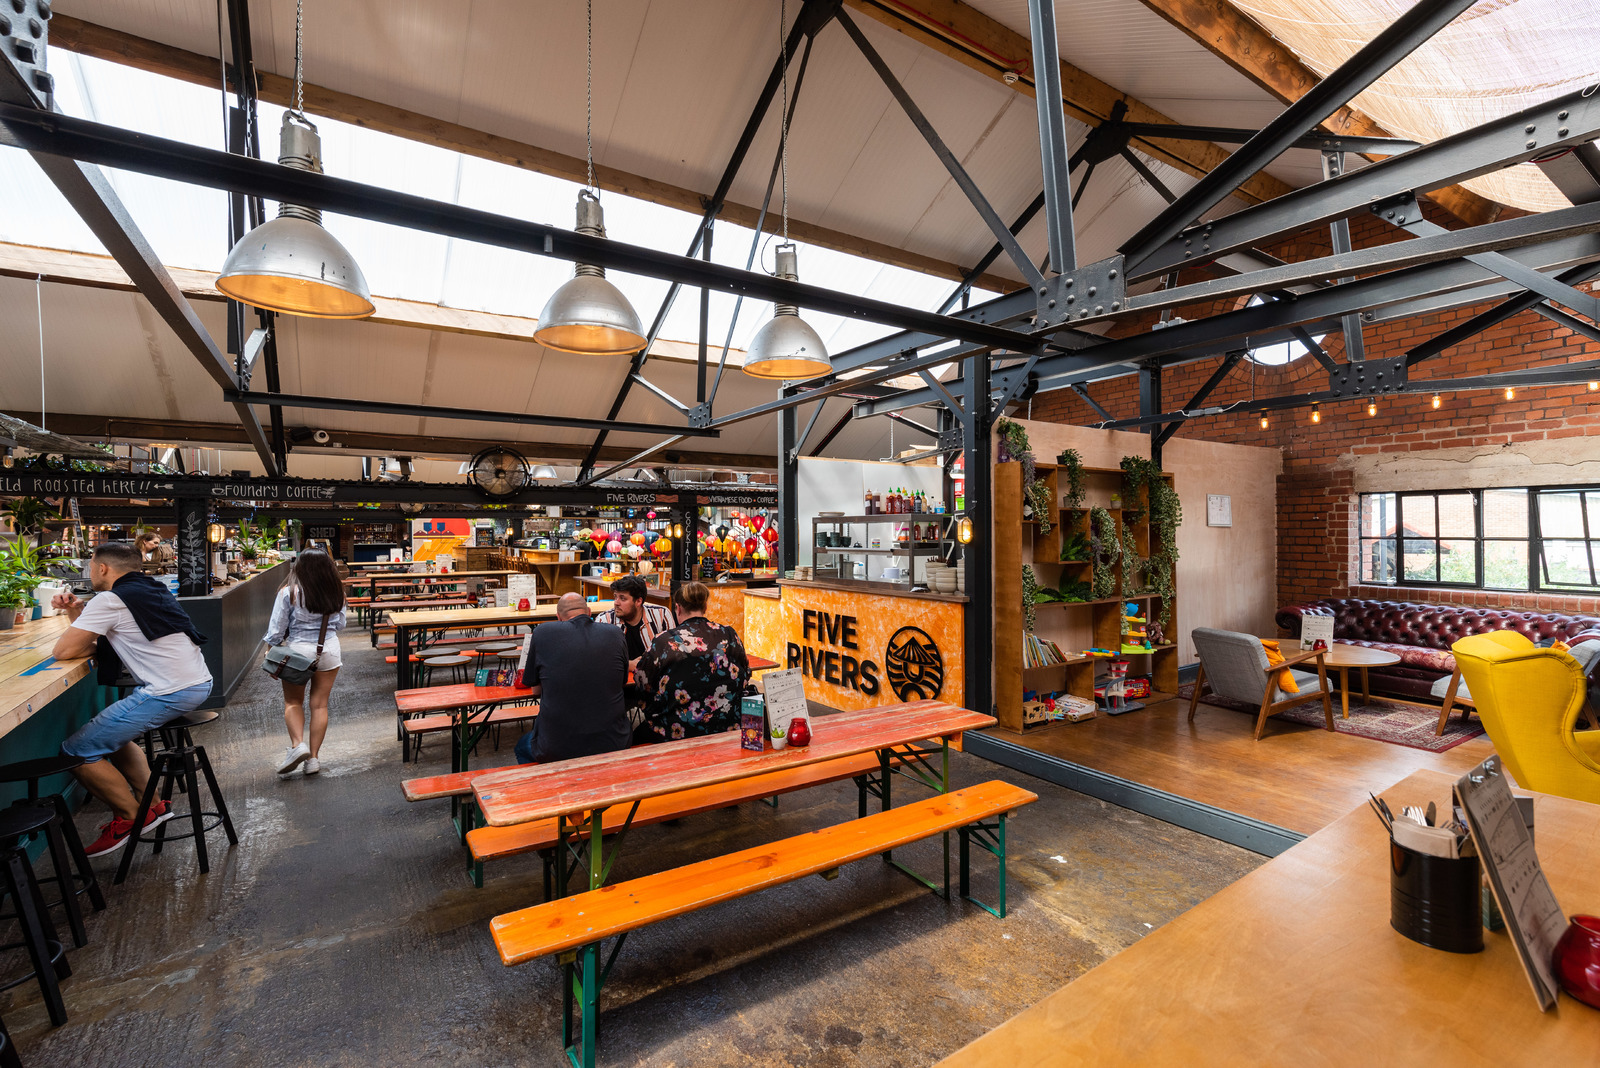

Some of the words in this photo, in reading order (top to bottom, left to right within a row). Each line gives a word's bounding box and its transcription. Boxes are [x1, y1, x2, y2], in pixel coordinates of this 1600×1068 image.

[286, 485, 322, 499] COFFEE
[606, 493, 626, 503] FIVE
[627, 493, 656, 504] RIVERS
[709, 495, 738, 504] VIETNAMESE
[739, 496, 753, 504] FOOD
[756, 496, 775, 504] COFFEE
[309, 527, 336, 538] SHED
[684, 511, 692, 580] COCKTAILS
[802, 608, 858, 650] FIVE
[787, 641, 880, 697] RIVERS
